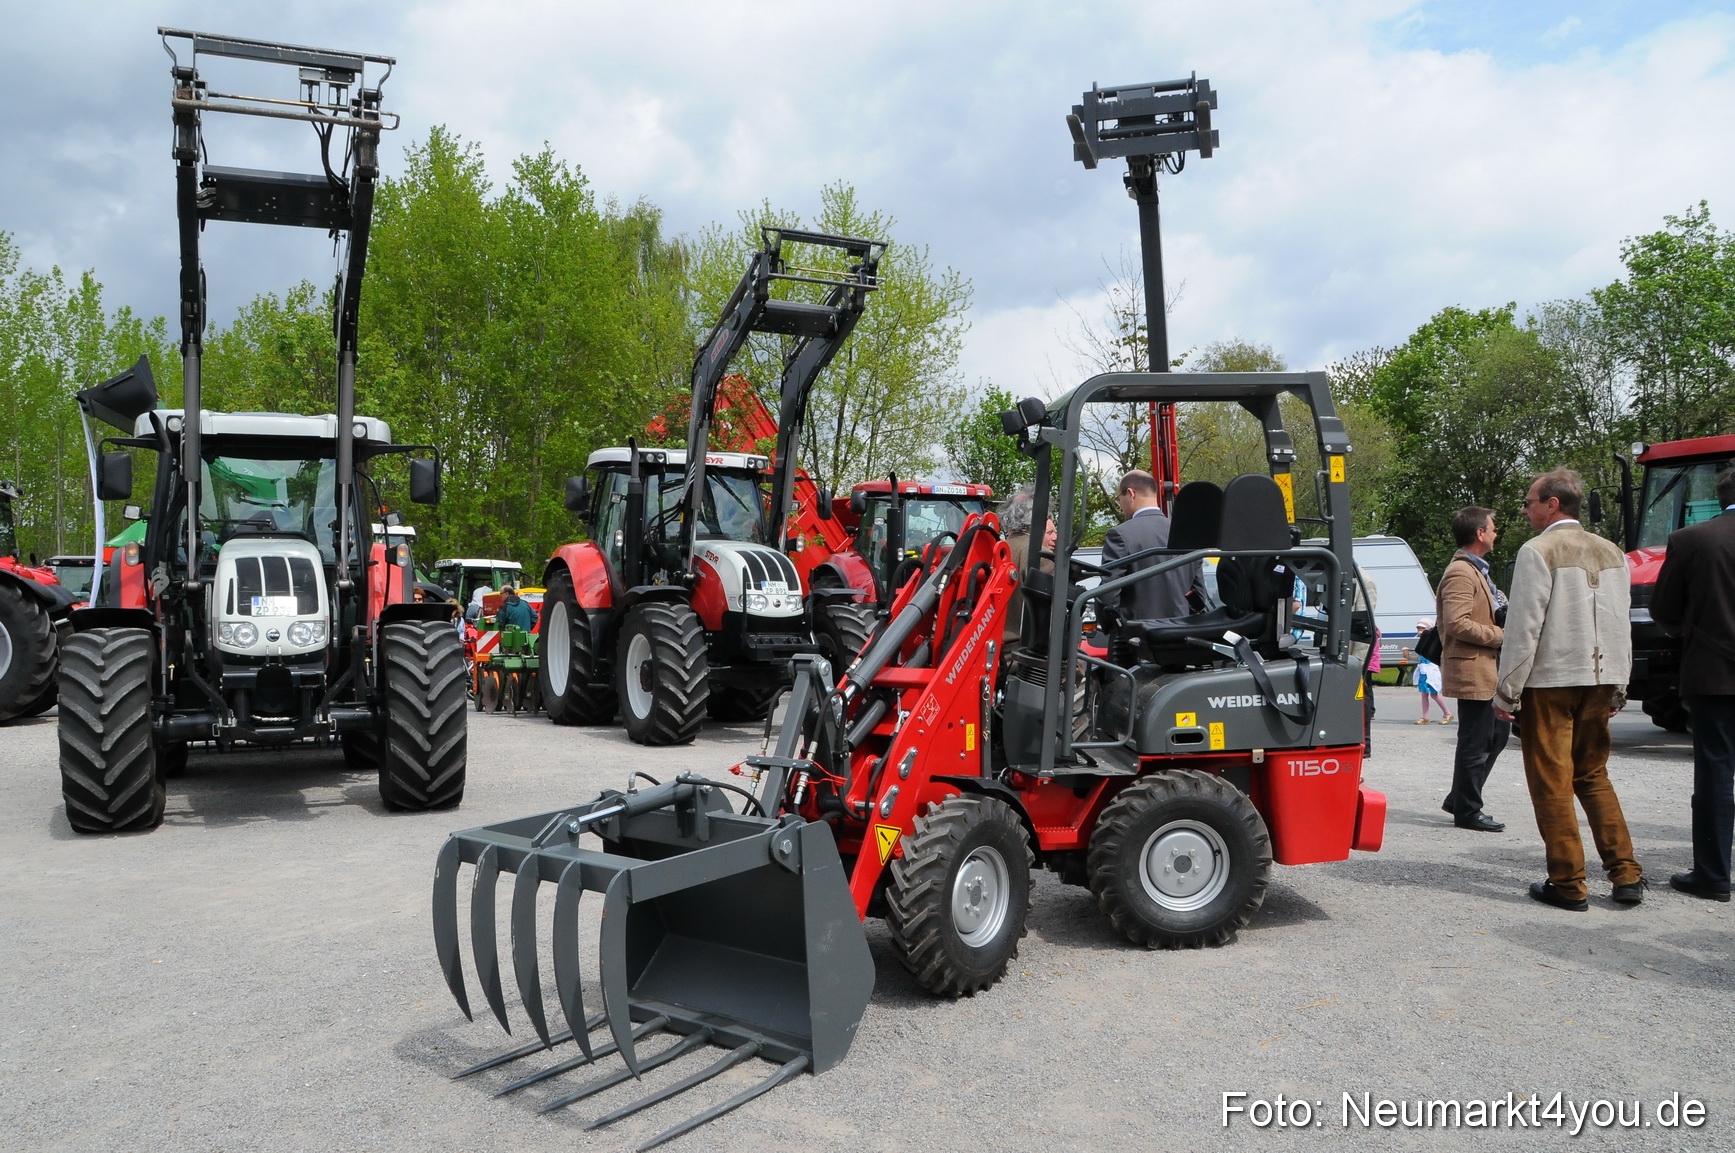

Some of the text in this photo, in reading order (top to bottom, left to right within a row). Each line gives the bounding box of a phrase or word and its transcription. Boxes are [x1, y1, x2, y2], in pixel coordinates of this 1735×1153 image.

[705, 456, 724, 464] EYR
[705, 550, 719, 565] STEYR
[256, 606, 270, 616] ZP
[945, 604, 995, 685] WEIDEMANN
[1287, 759, 1340, 776] 1150
